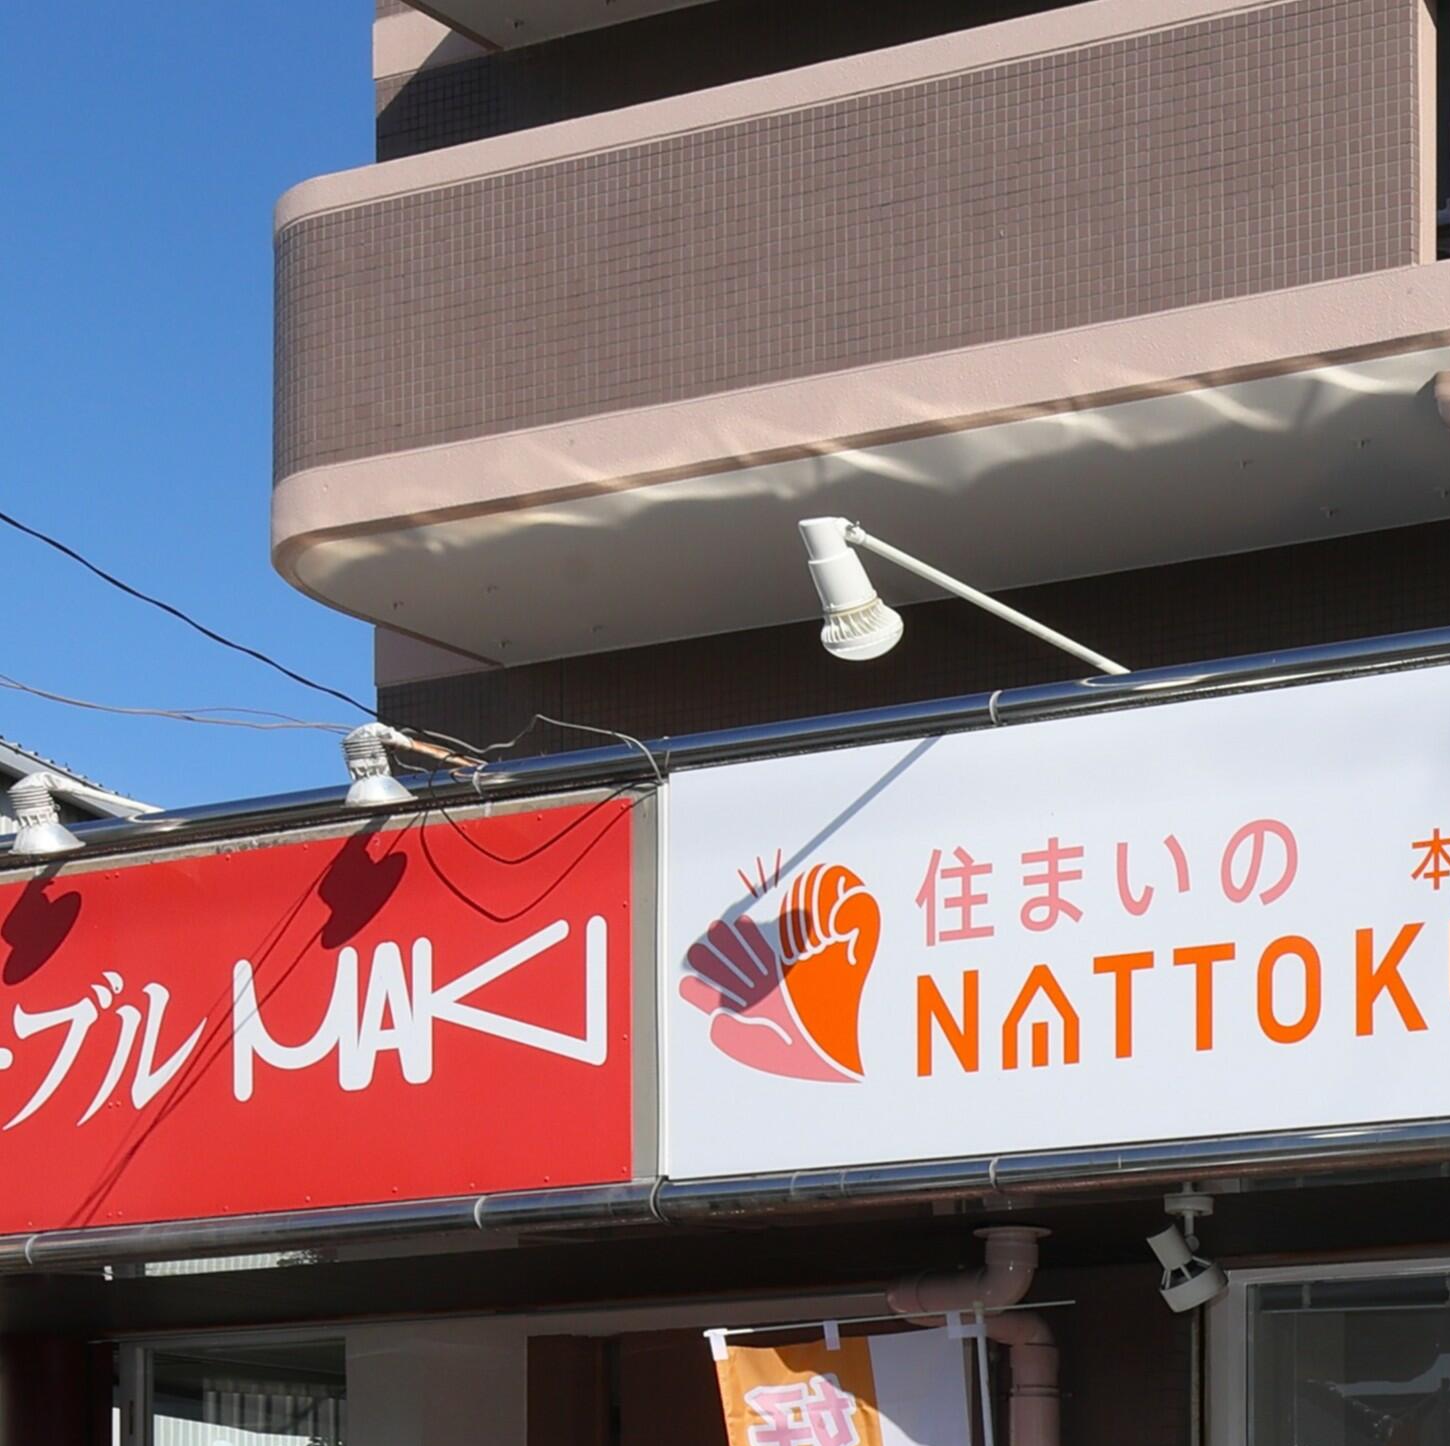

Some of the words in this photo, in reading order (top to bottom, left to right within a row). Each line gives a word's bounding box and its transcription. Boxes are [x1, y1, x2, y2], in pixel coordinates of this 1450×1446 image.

[916, 818, 1299, 948] 住まいの
[0, 971, 207, 1131] ブル
[233, 914, 608, 1103] MAKI
